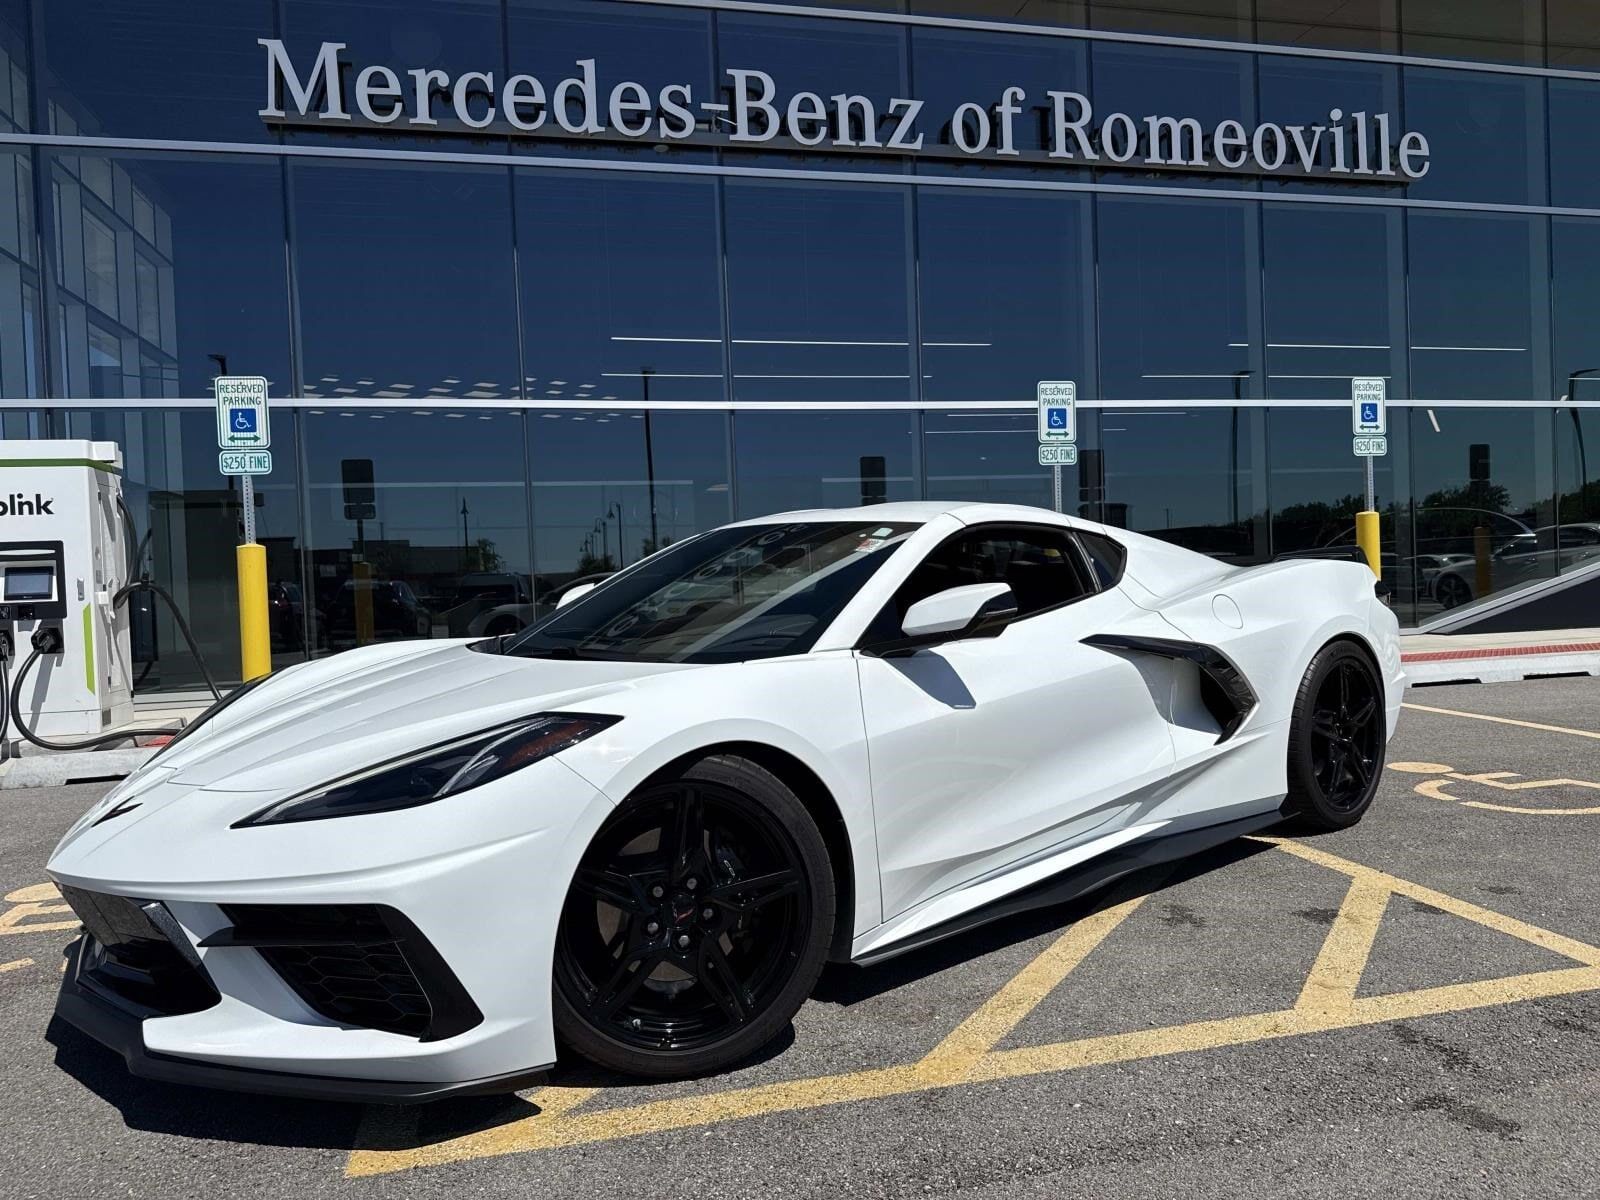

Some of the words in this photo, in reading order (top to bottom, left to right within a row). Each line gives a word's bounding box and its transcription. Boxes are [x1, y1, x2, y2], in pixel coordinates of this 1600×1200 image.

[257, 38, 925, 151] Mercedes-Benz
[951, 86, 1026, 156] of
[1046, 90, 1431, 179] Romeoville
[219, 384, 264, 394] RESERVED
[1040, 387, 1073, 396] RESERVED
[1354, 383, 1383, 392] RESERVED
[223, 396, 262, 406] PARKING
[1042, 398, 1071, 406] PARKING
[1356, 393, 1382, 401] PARKING
[1355, 440, 1371, 452] $250
[1372, 440, 1384, 452] FINE
[1041, 449, 1058, 461] $250
[1060, 448, 1074, 461] FINE
[223, 456, 246, 470] $250
[249, 455, 268, 469] FINE
